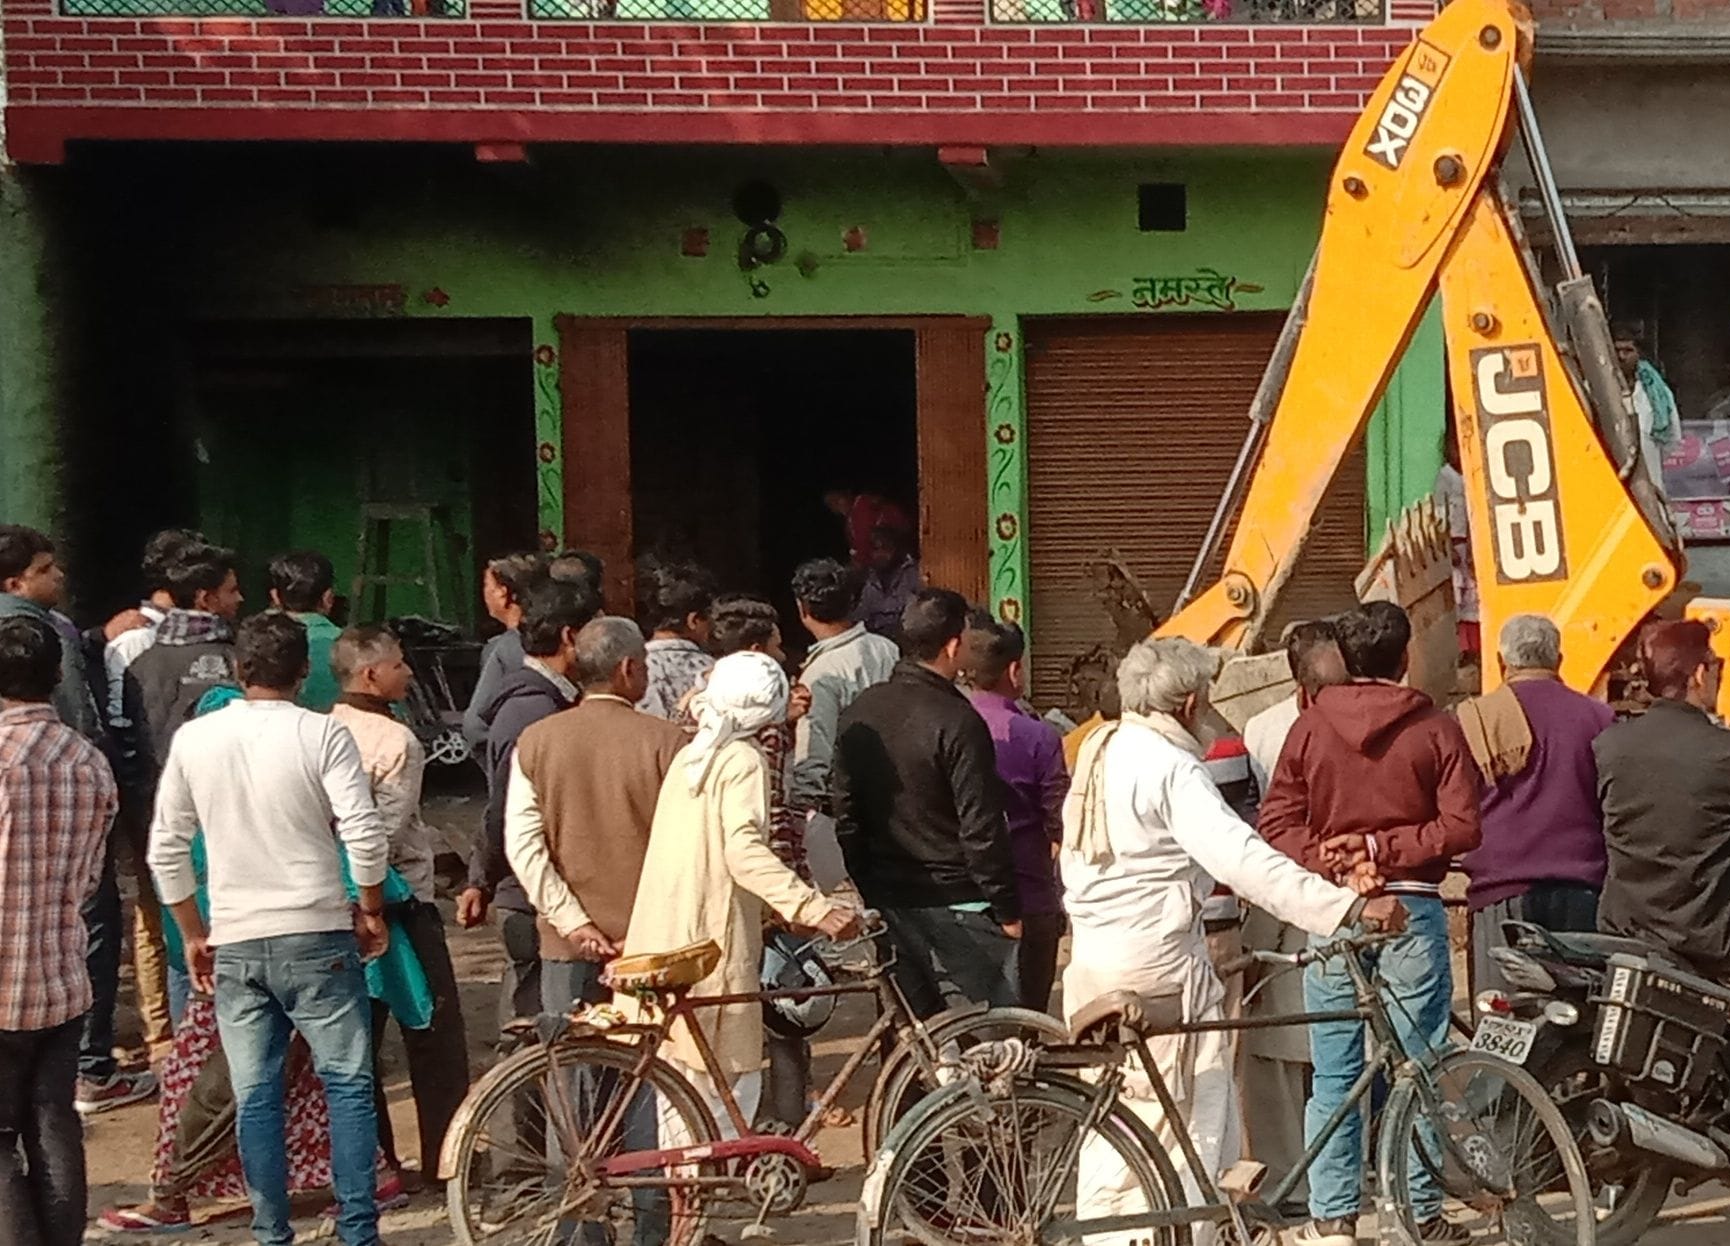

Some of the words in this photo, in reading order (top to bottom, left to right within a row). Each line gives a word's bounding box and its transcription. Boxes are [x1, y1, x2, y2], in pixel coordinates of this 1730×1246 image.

[1366, 75, 1430, 167] 3DX
[1132, 267, 1236, 311] नमस्ते
[1477, 352, 1560, 580] JCB
[1474, 1032, 1526, 1057] 3840
